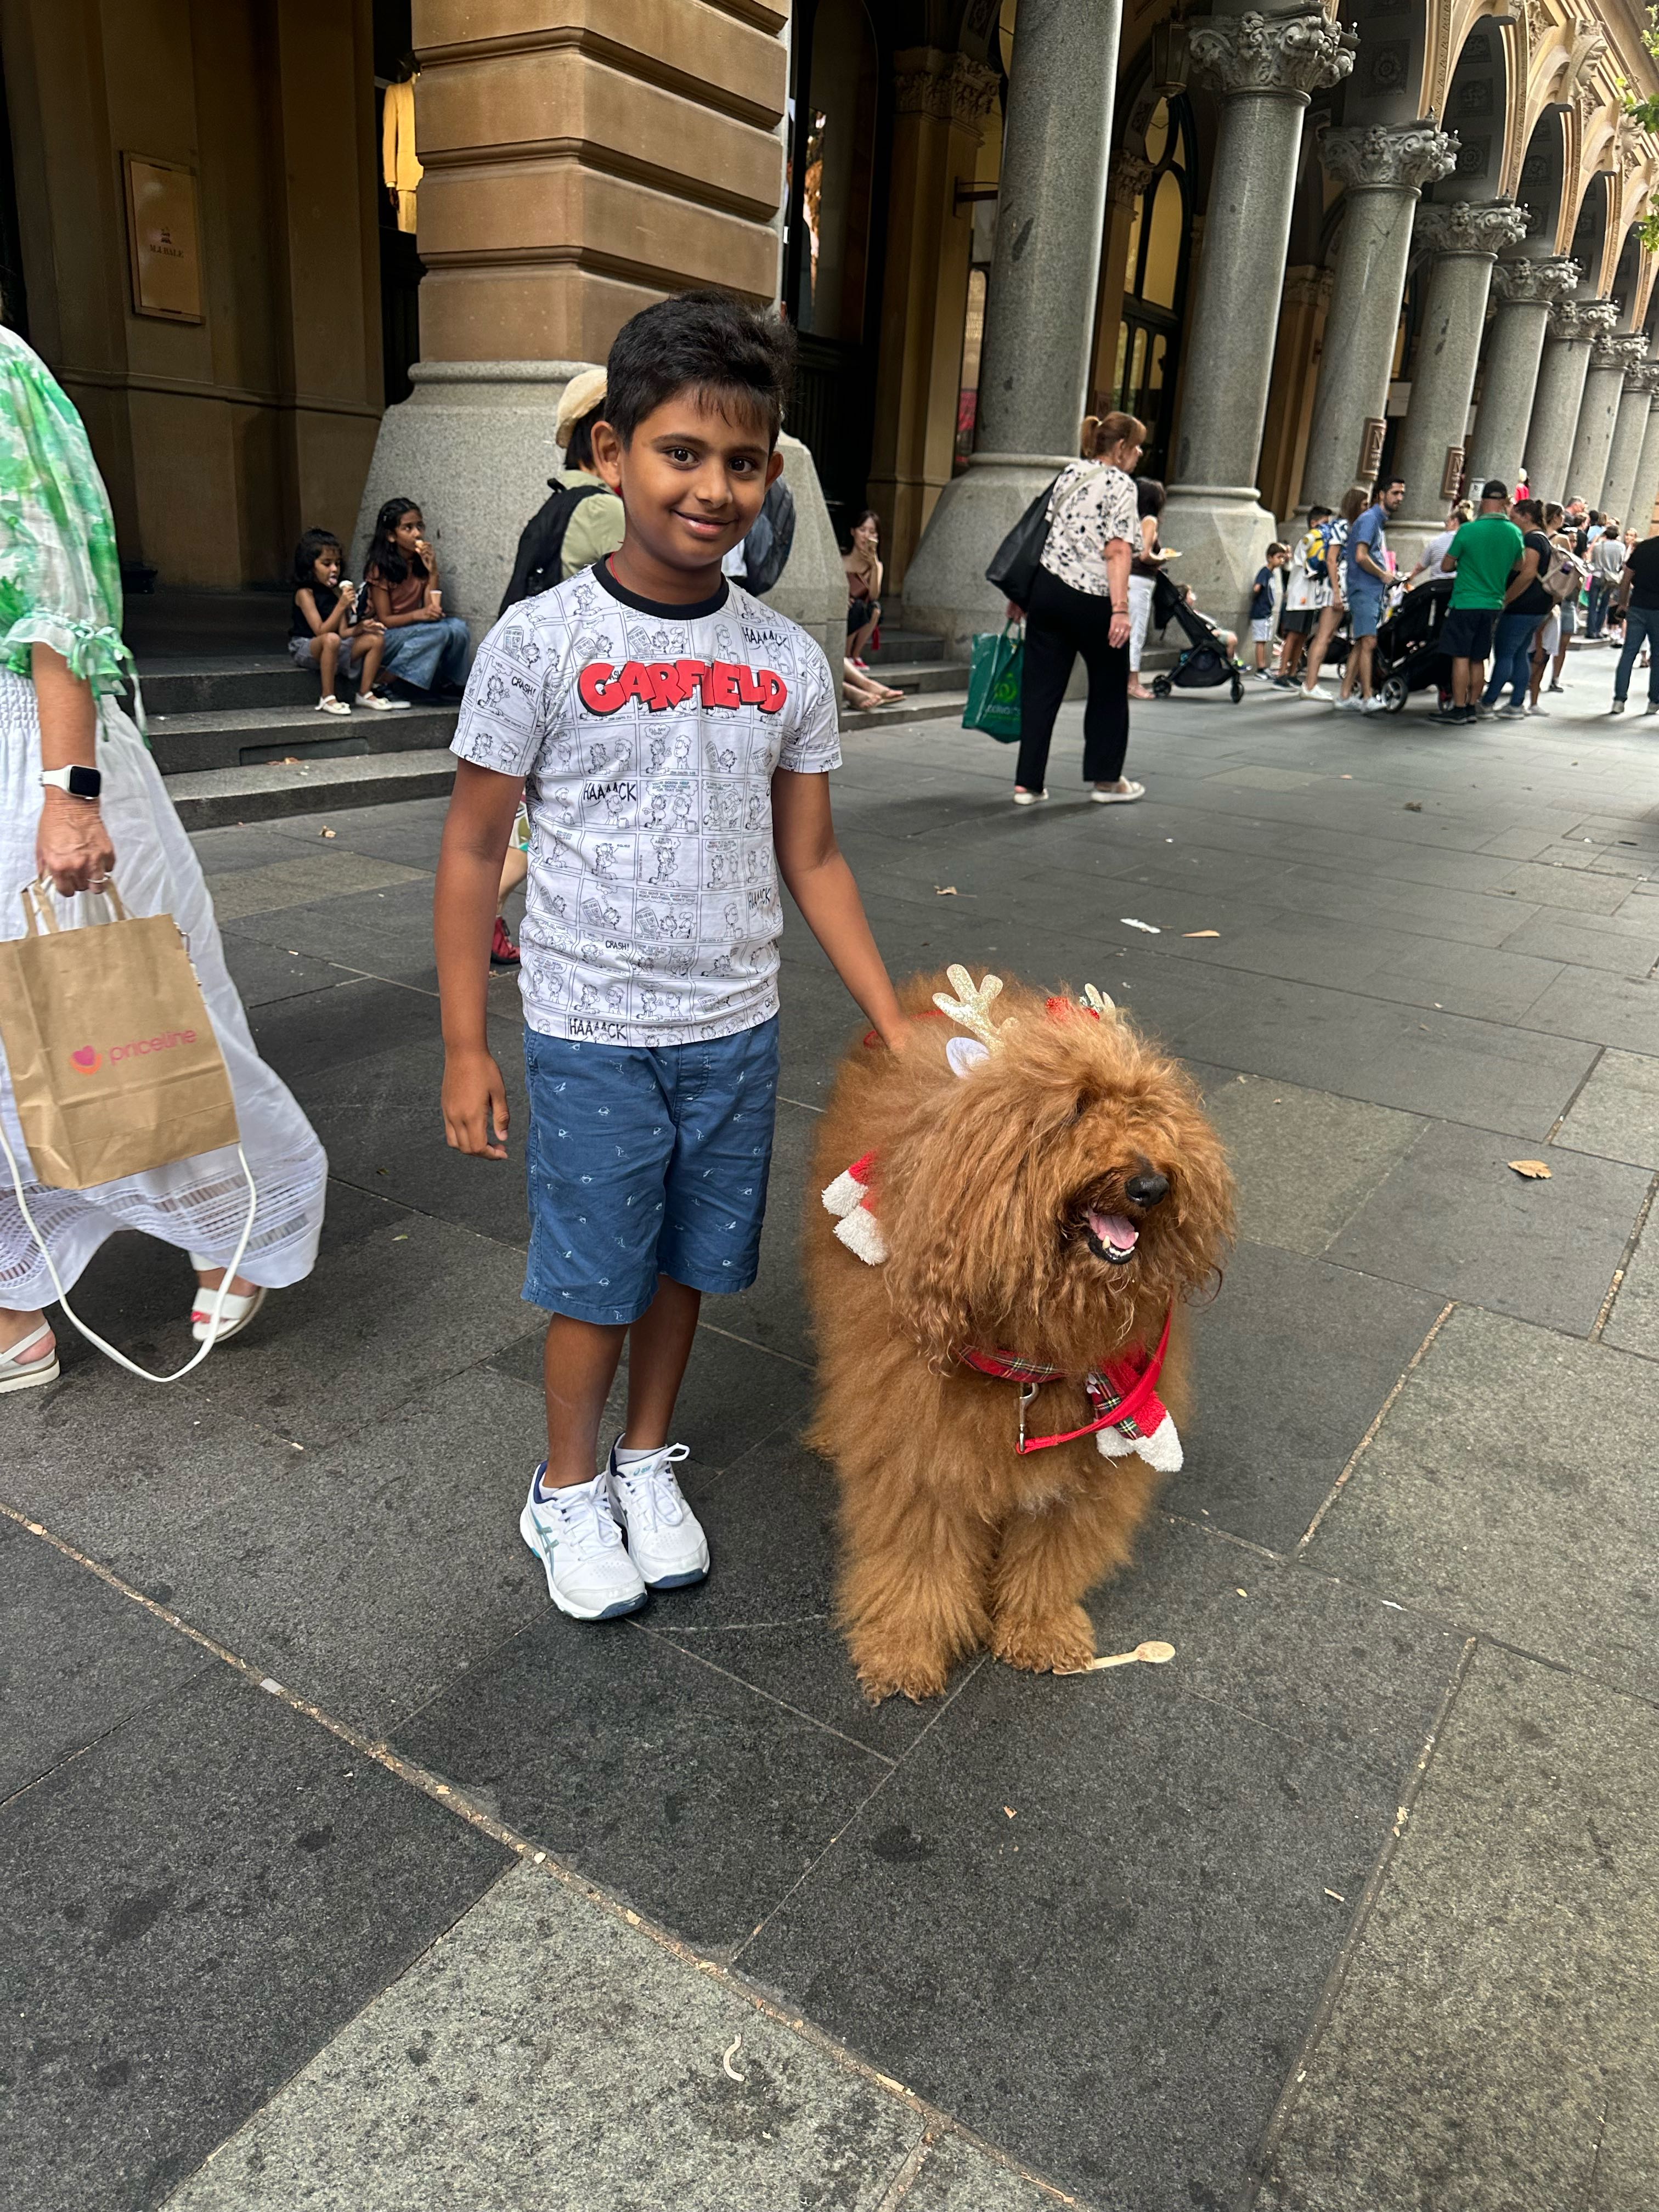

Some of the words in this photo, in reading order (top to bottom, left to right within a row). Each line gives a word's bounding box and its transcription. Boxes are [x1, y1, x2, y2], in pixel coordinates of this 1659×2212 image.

[511, 676, 537, 698] CRASH!
[578, 659, 788, 716] GARFIELD
[606, 940, 629, 951] CRASH!
[109, 1029, 196, 1066] priceline
